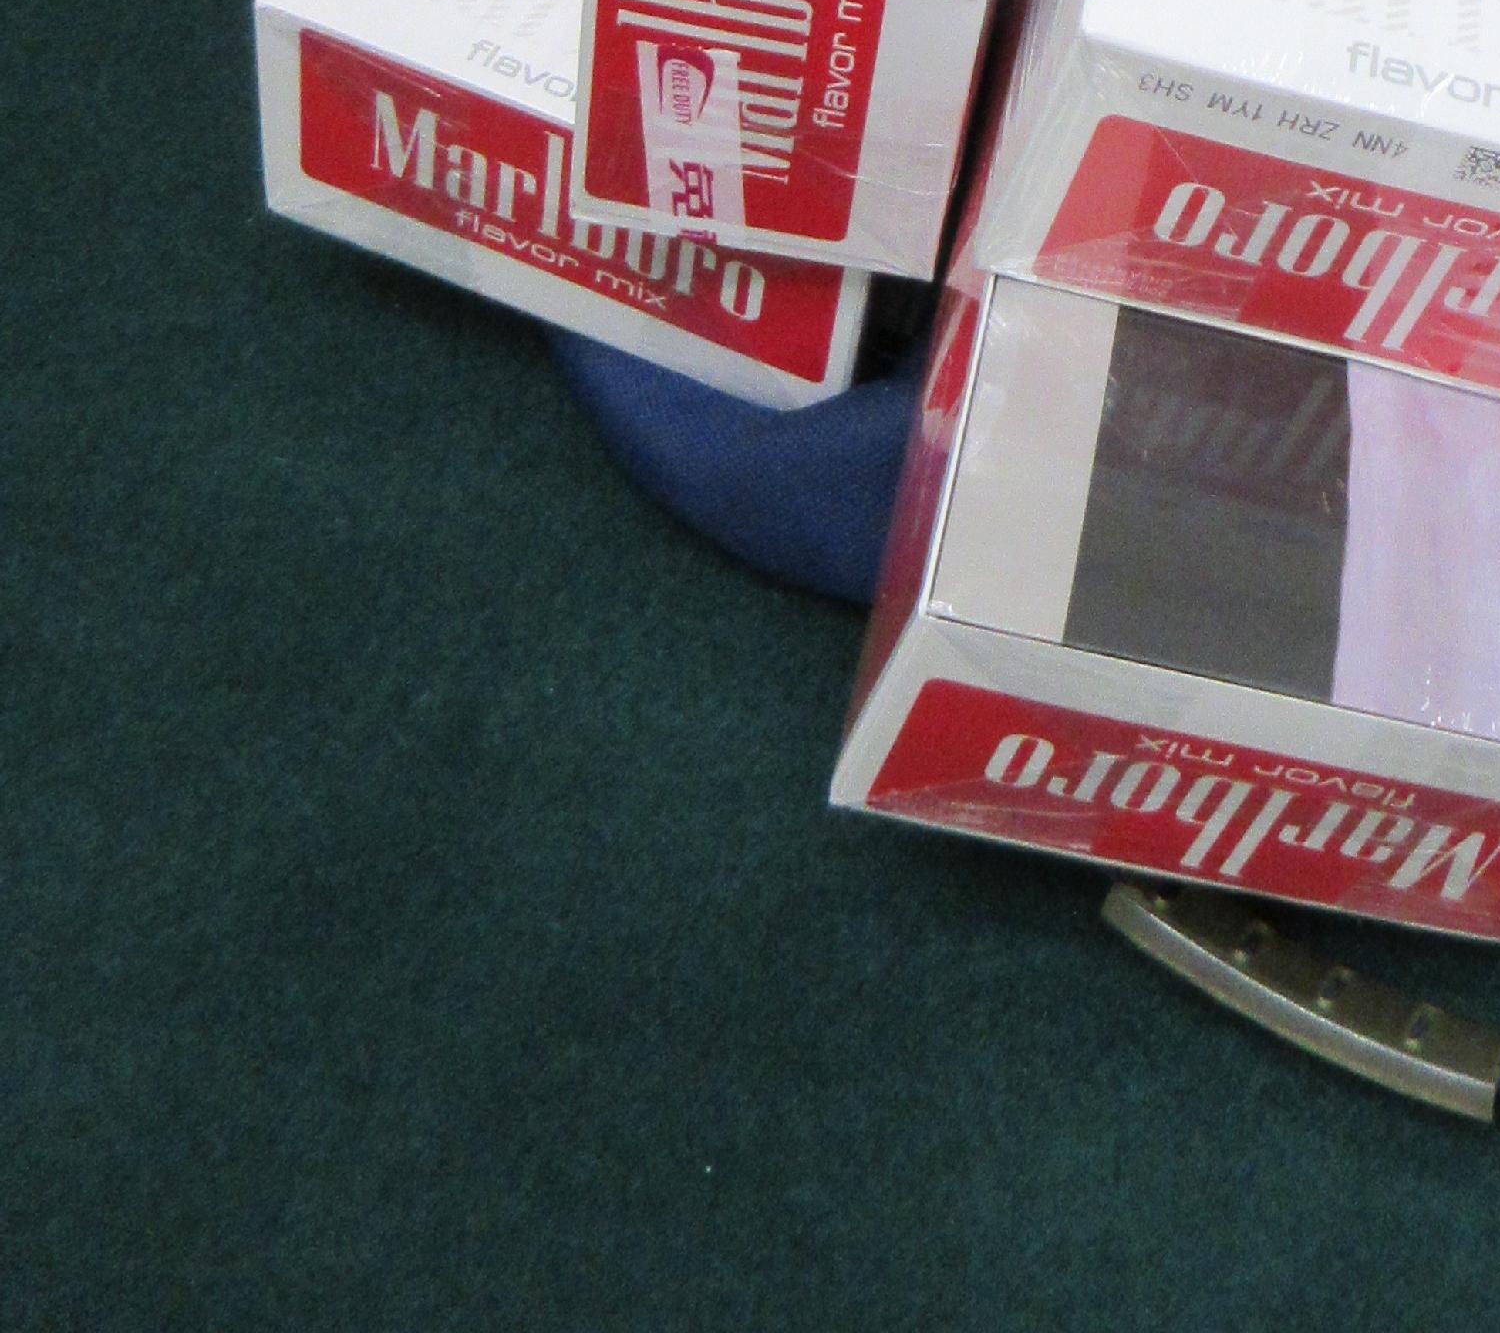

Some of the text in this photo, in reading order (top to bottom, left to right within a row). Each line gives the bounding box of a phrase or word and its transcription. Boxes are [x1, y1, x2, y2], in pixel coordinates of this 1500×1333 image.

[812, 32, 858, 130] flavor
[1137, 73, 1193, 103] SH3
[1277, 111, 1341, 142] ZRH
[1354, 129, 1409, 159] 4NN
[1306, 178, 1406, 216] mix
[454, 210, 669, 312] flavor mix
[1133, 732, 1420, 813] flavor mix
